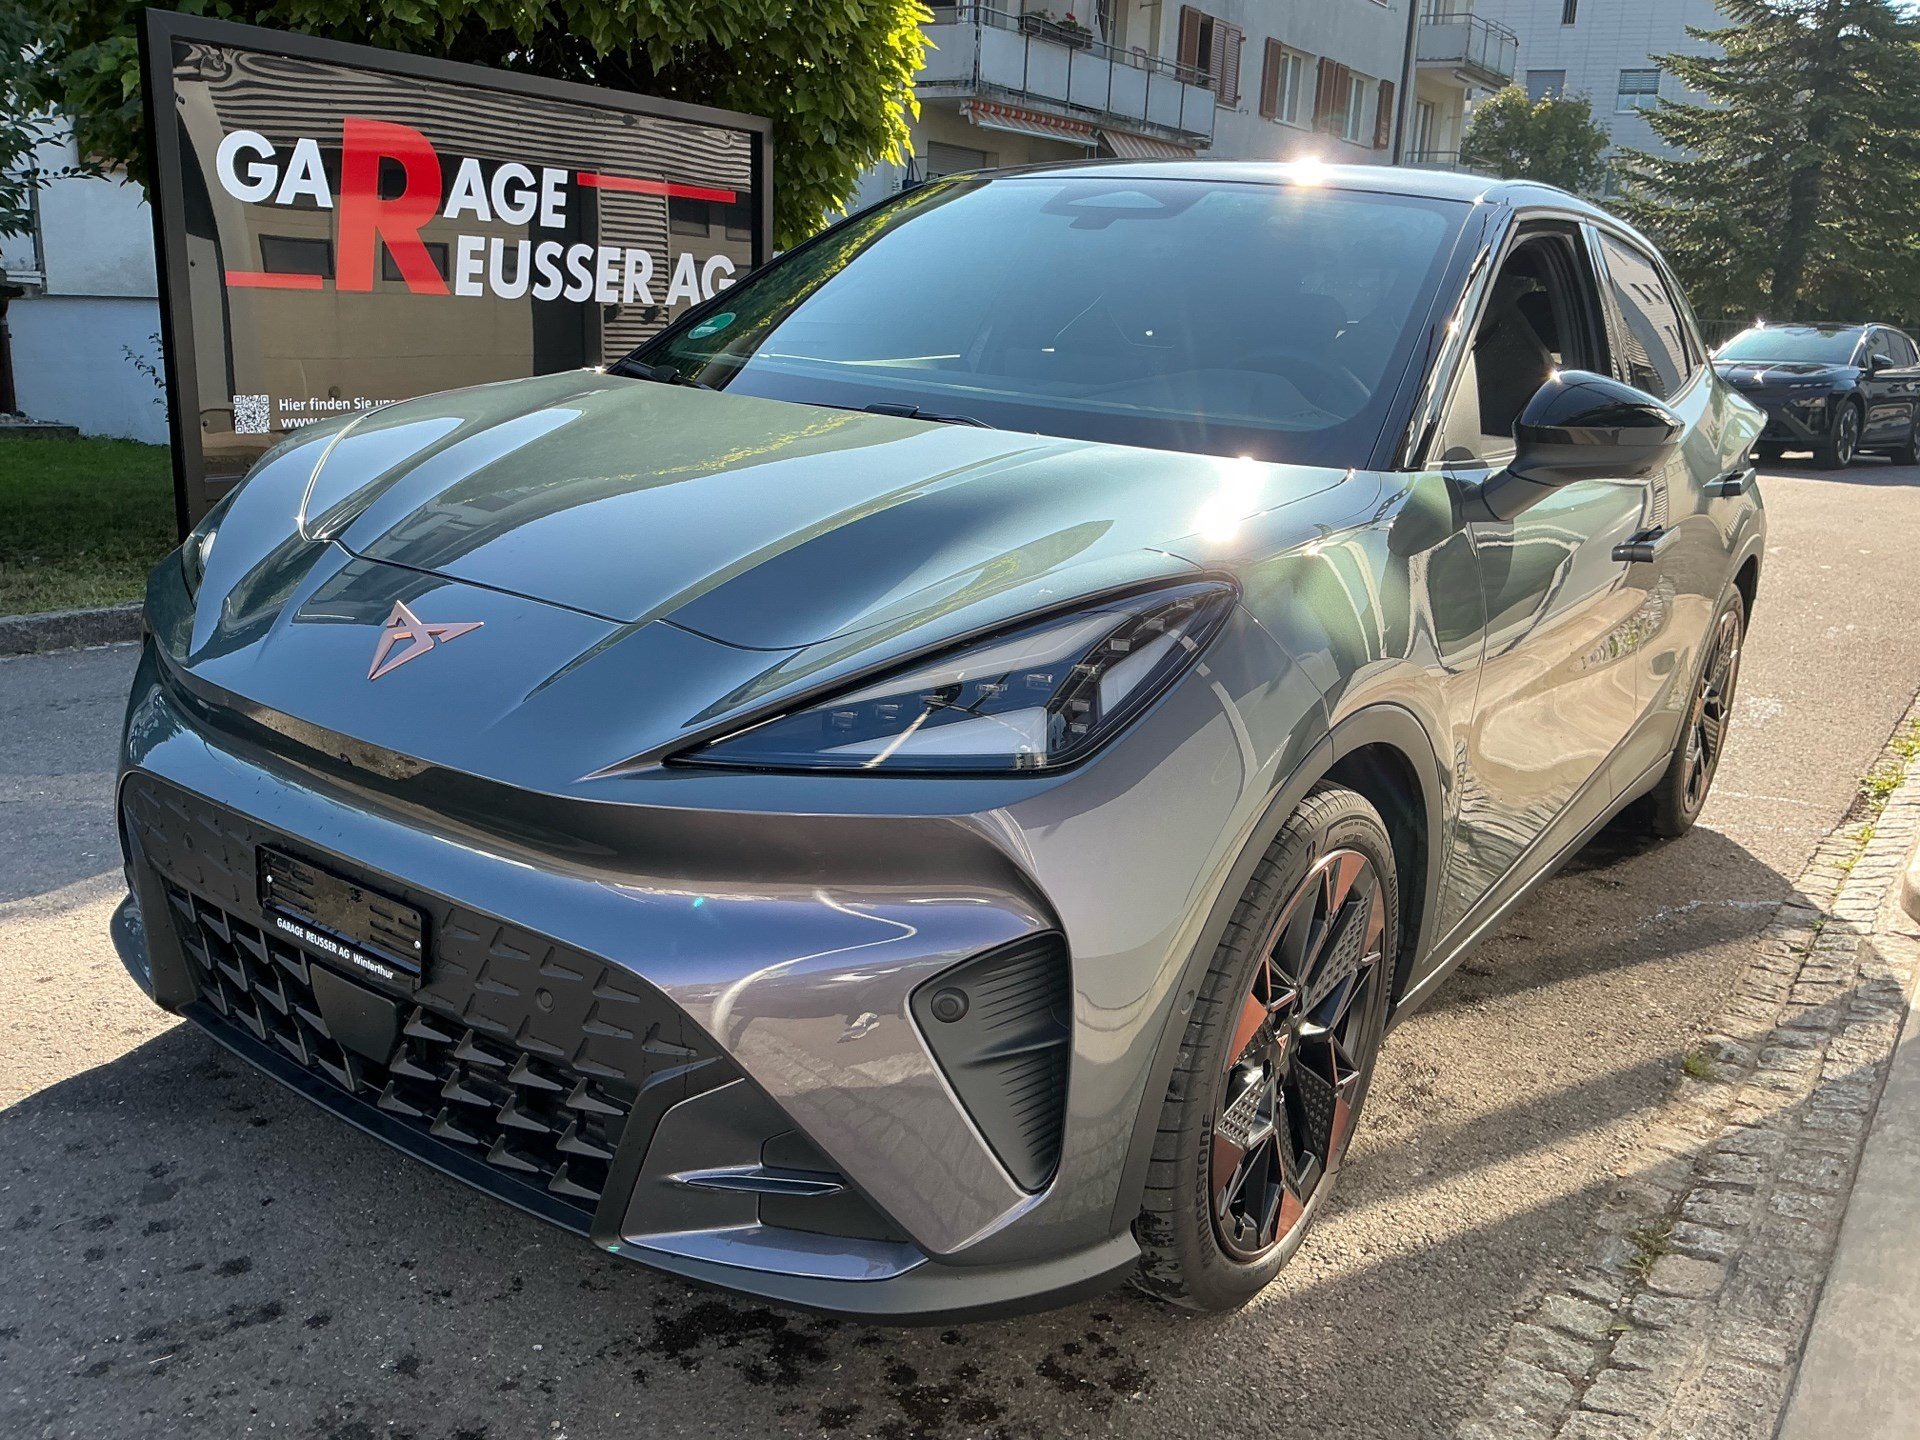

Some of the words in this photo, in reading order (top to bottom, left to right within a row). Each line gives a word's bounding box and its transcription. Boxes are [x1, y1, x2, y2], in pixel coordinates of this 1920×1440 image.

[664, 252, 737, 306] AG
[279, 398, 306, 411] Hier
[309, 397, 351, 411] finden
[354, 396, 373, 410] Sie
[276, 917, 304, 939] GARAGE
[306, 930, 337, 954] REUSSER
[338, 947, 350, 960] AG
[353, 953, 394, 980] Winterthur
